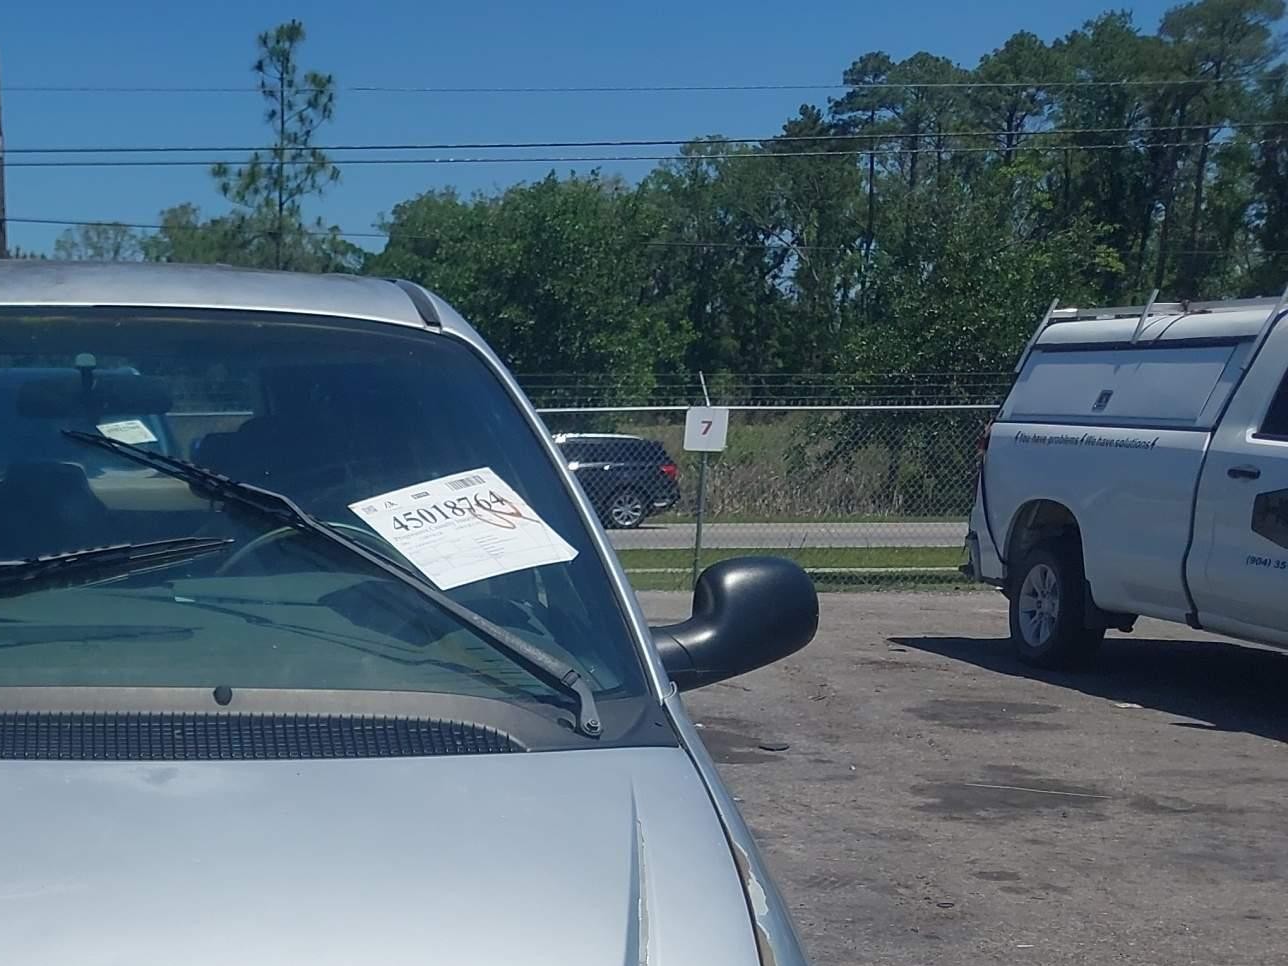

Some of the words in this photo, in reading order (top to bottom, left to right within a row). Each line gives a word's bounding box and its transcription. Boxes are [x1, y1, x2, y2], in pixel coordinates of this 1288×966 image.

[701, 420, 713, 435] 7
[1048, 435, 1080, 446] problems
[1096, 437, 1115, 447] have
[1115, 438, 1150, 449] solutions
[393, 490, 507, 531] 45018764
